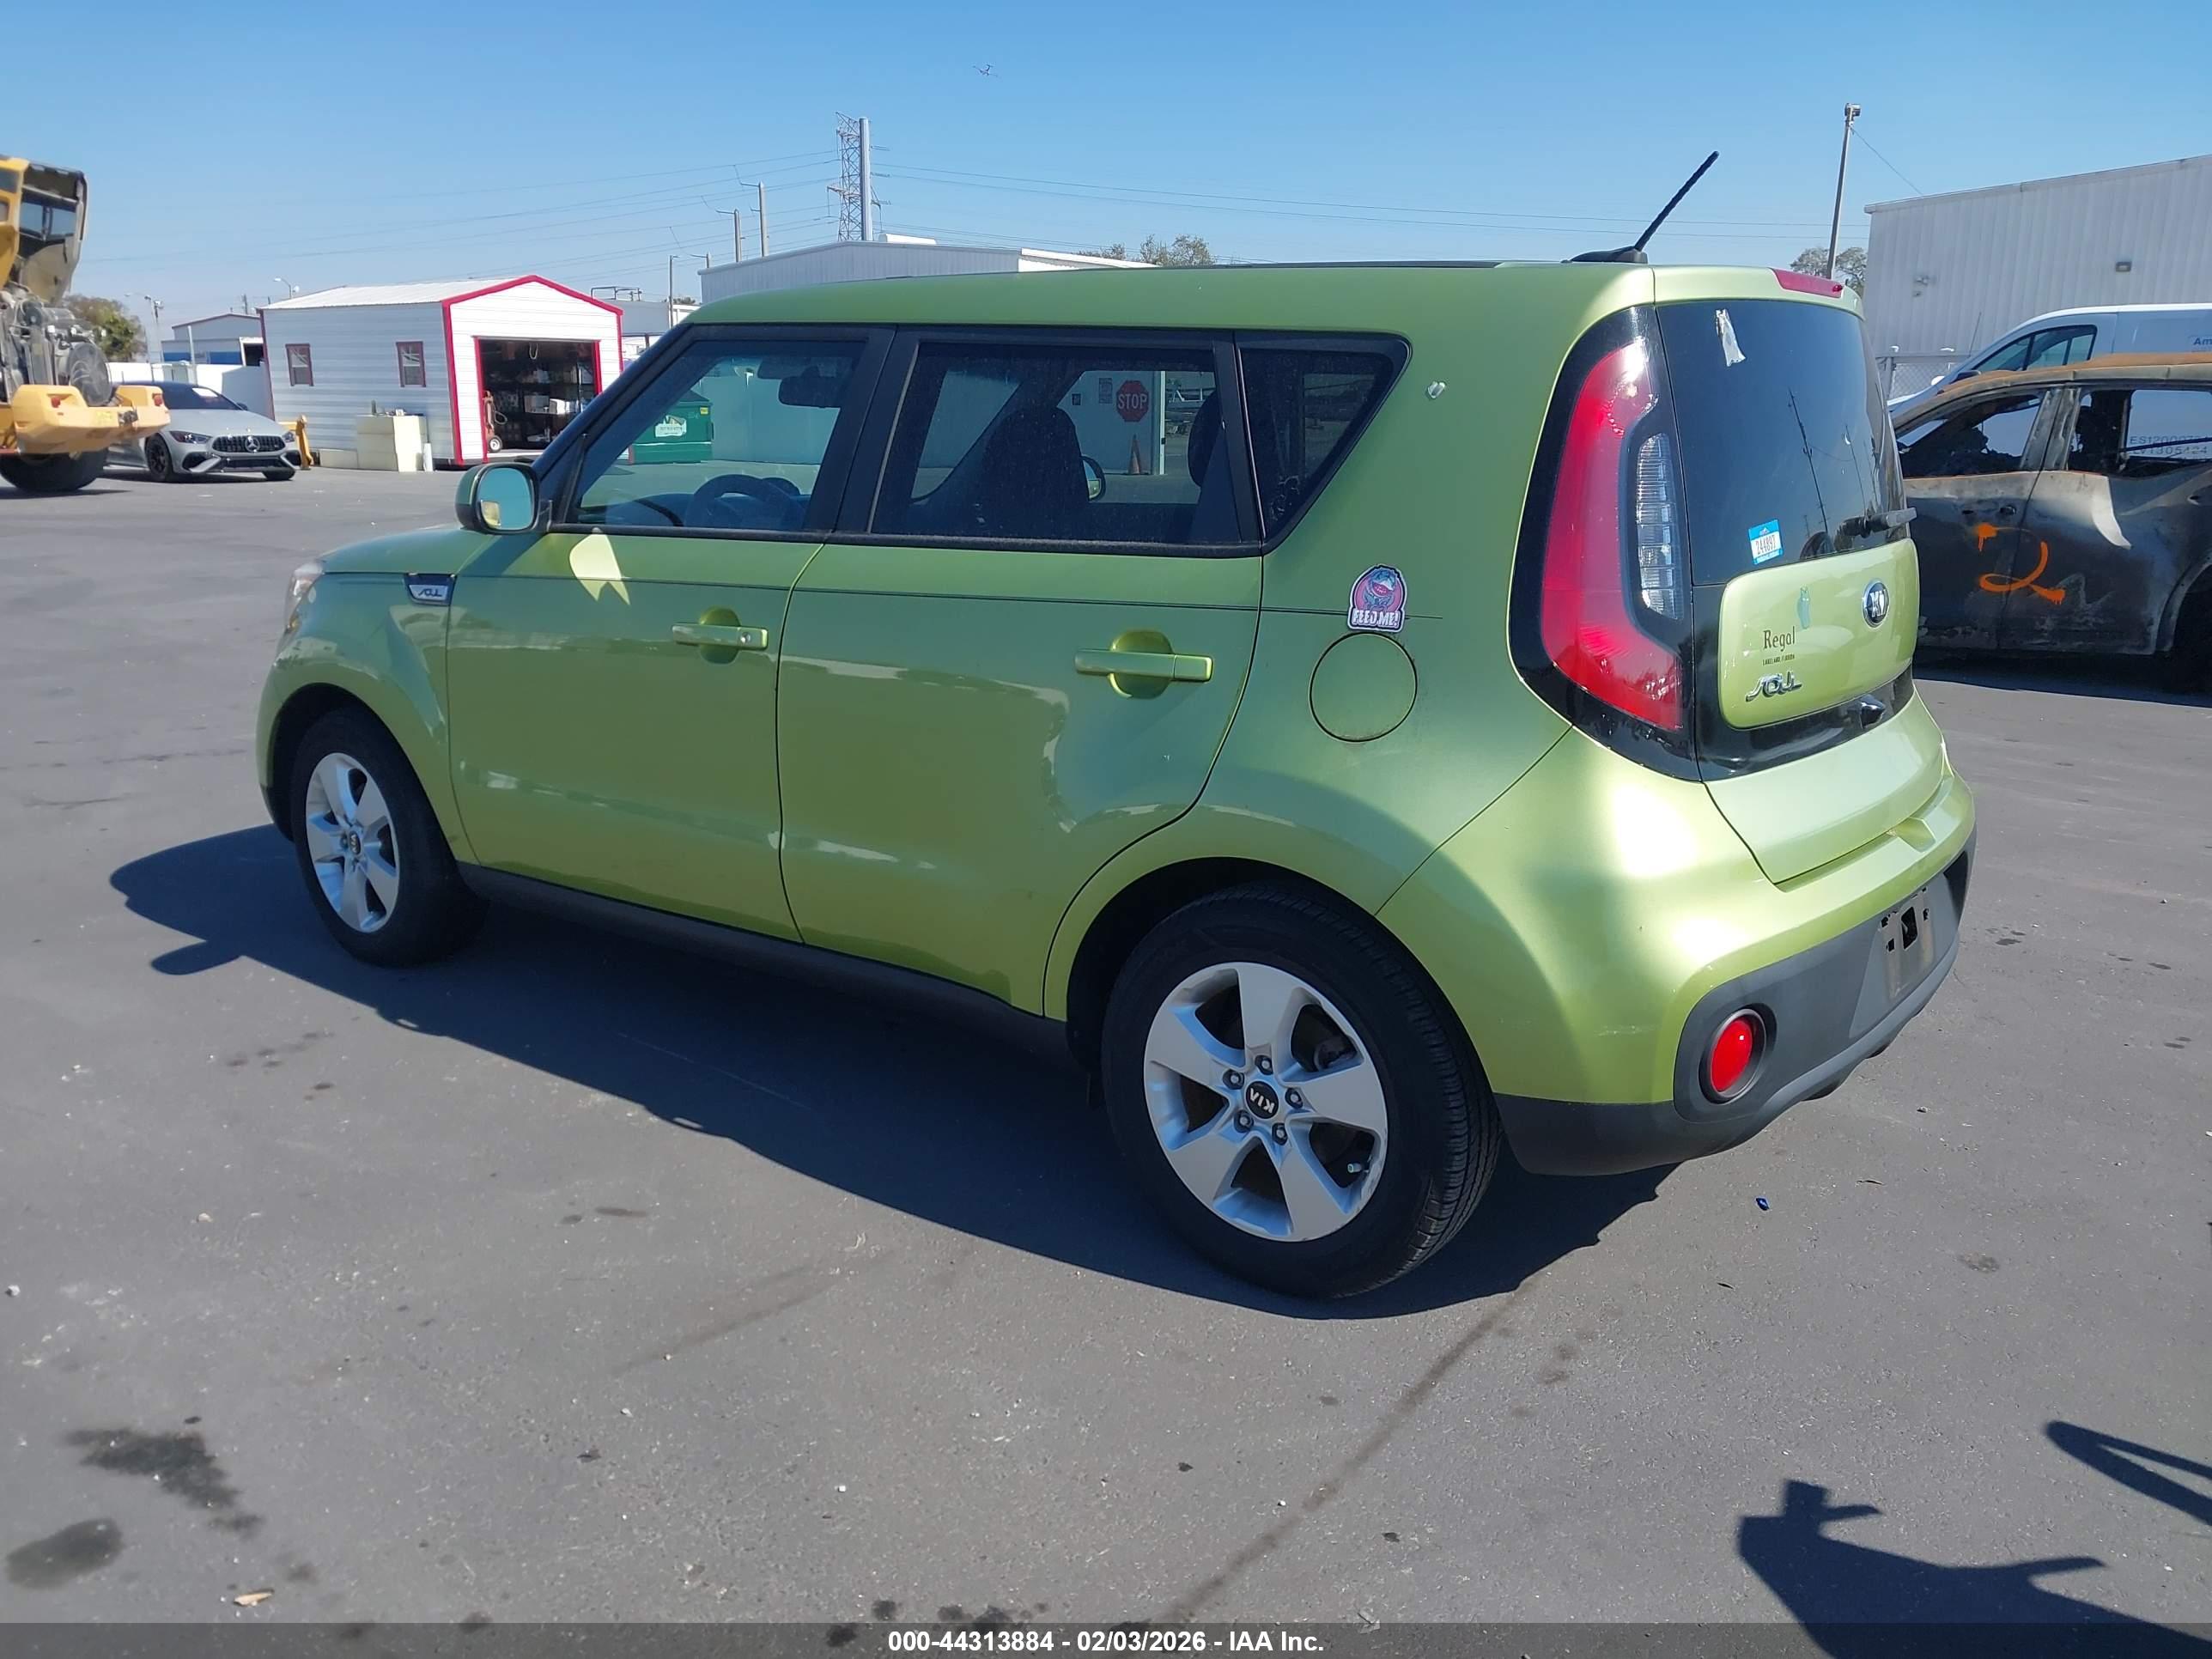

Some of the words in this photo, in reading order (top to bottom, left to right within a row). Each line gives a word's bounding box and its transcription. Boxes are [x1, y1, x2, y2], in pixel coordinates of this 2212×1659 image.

[1118, 393, 1147, 410] STOP
[1978, 522, 2066, 605] 2
[1352, 608, 1377, 625] FEED
[1378, 611, 1399, 628] ME!
[1763, 625, 1795, 652] Regal
[1249, 1087, 1275, 1114] KIA
